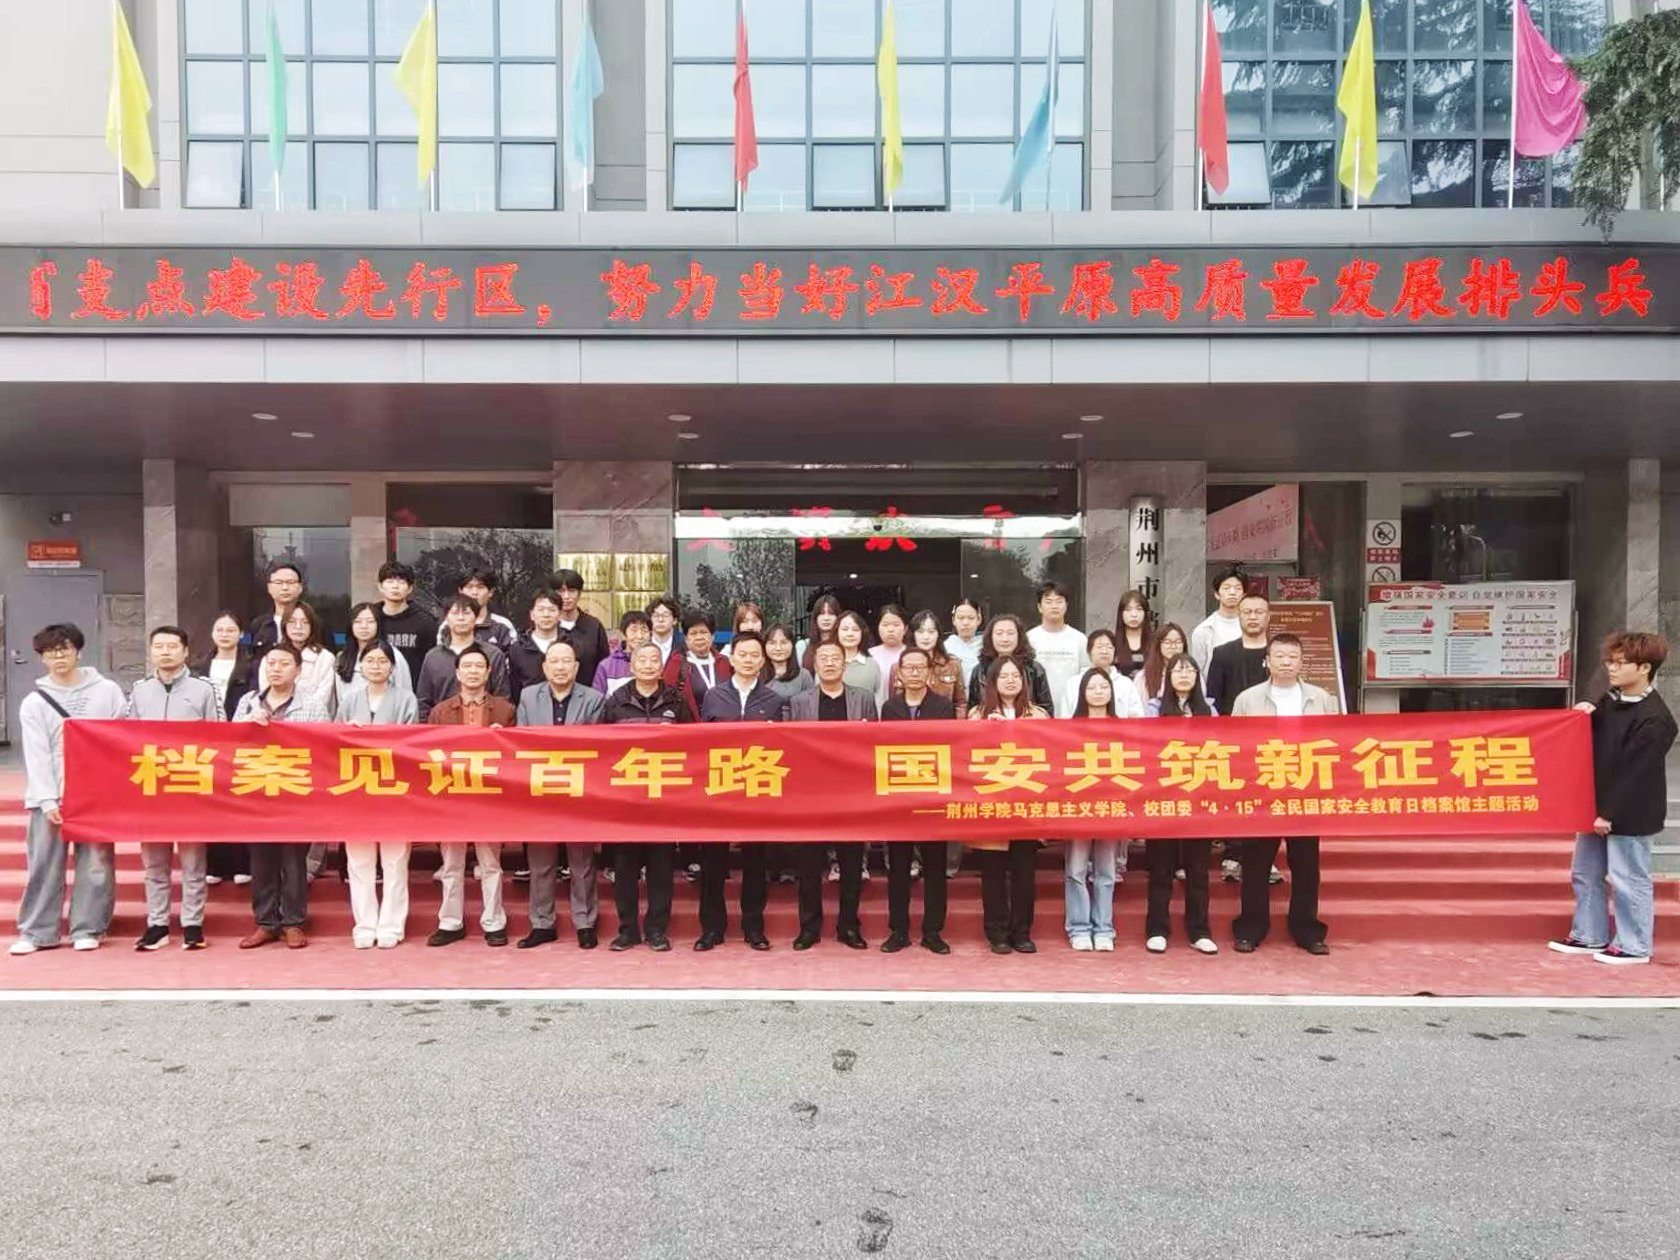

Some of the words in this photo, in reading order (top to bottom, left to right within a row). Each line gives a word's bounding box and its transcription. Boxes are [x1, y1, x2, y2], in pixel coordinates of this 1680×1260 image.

[1135, 507, 1161, 632] 荆州市
[129, 744, 792, 799] 档案见证百年路
[873, 736, 1540, 797] 国安共筑新征程
